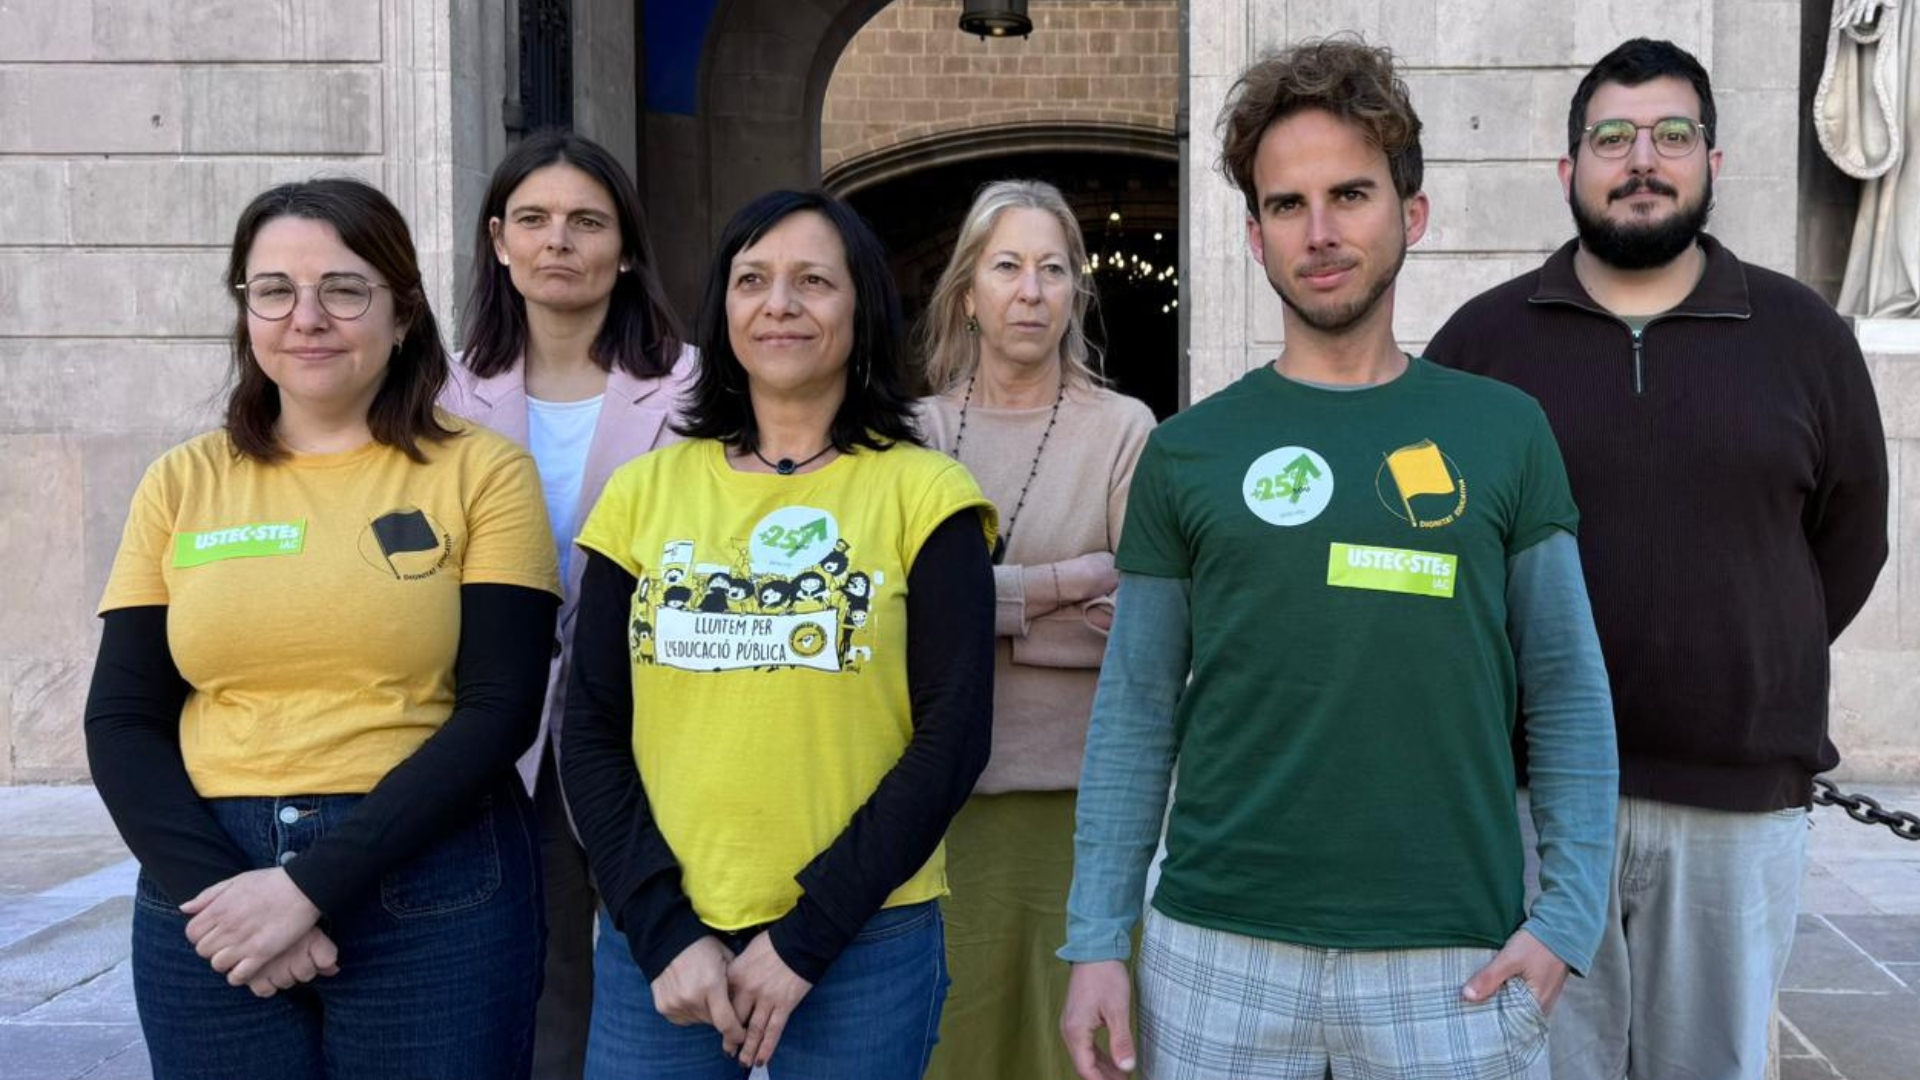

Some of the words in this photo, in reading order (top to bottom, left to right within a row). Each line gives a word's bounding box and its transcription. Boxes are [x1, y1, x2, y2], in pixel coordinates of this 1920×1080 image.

[695, 616, 747, 635] LLUITEM
[751, 618, 773, 636] PER
[664, 638, 731, 659] L'EDUCACIÓ
[735, 639, 787, 661] PÚBLICA
